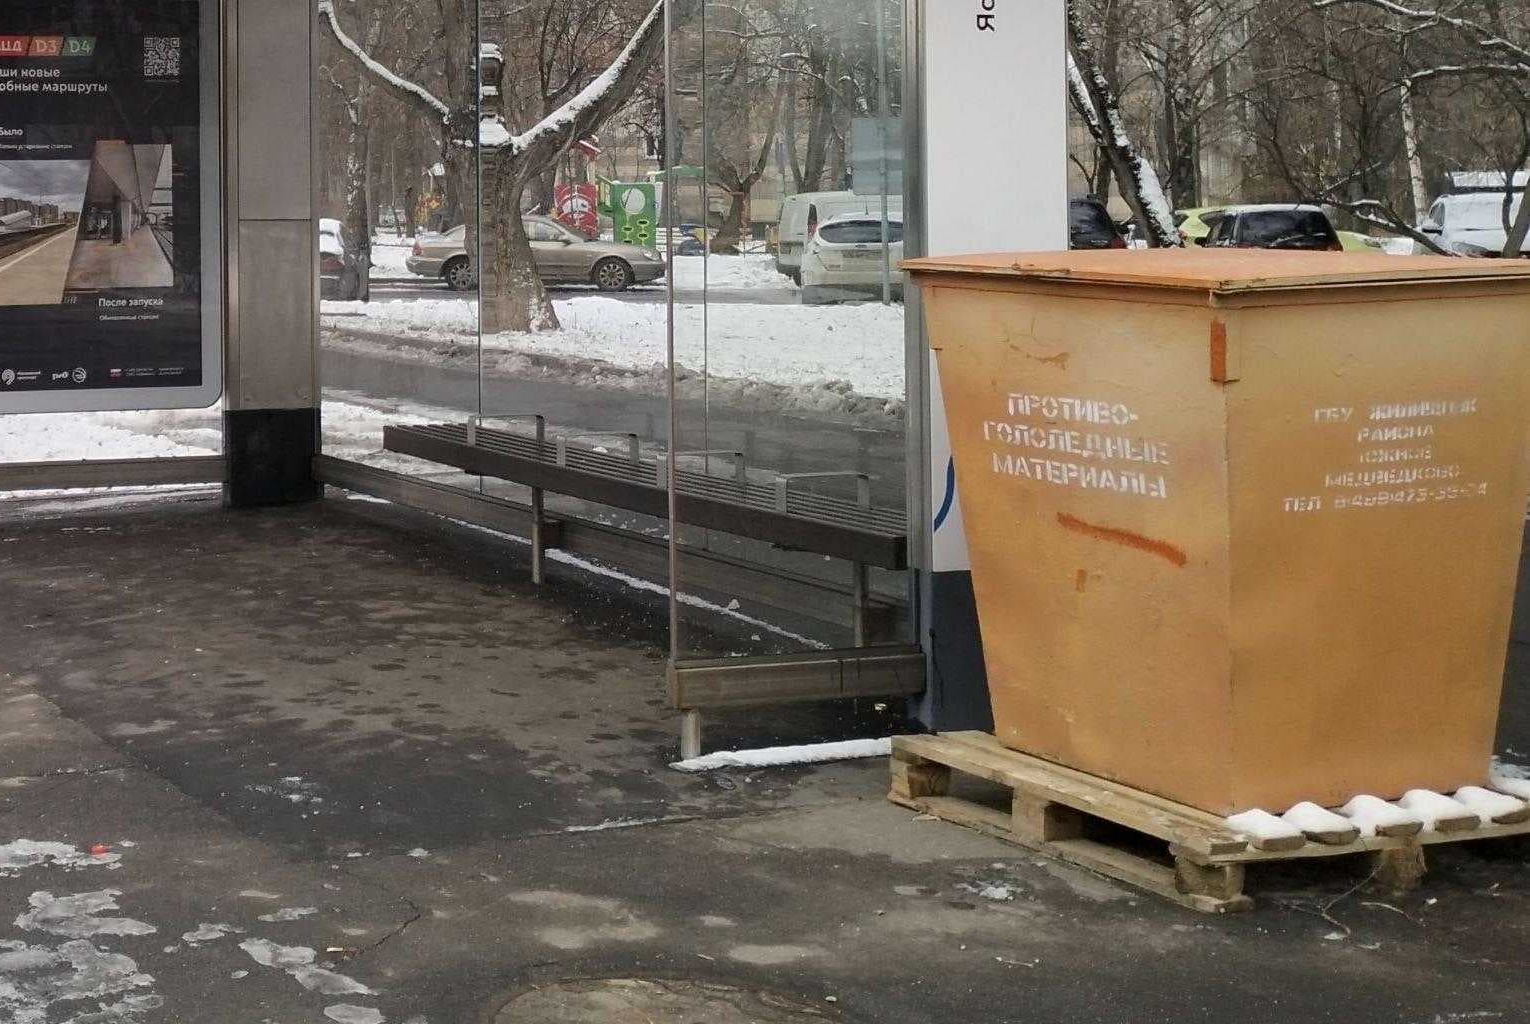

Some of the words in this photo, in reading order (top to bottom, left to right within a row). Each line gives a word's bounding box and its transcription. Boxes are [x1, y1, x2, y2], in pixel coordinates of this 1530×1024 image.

[35, 39, 58, 54] D3
[69, 39, 91, 54] D4
[21, 68, 61, 78] новые
[42, 81, 108, 94] маршруты
[98, 297, 127, 308] После
[1007, 392, 1139, 425] ПРОТИВО-
[983, 420, 1170, 465] ГОЛОЛЕДНЫЕ
[991, 451, 1167, 498] МАТЕРИАЛЫ
